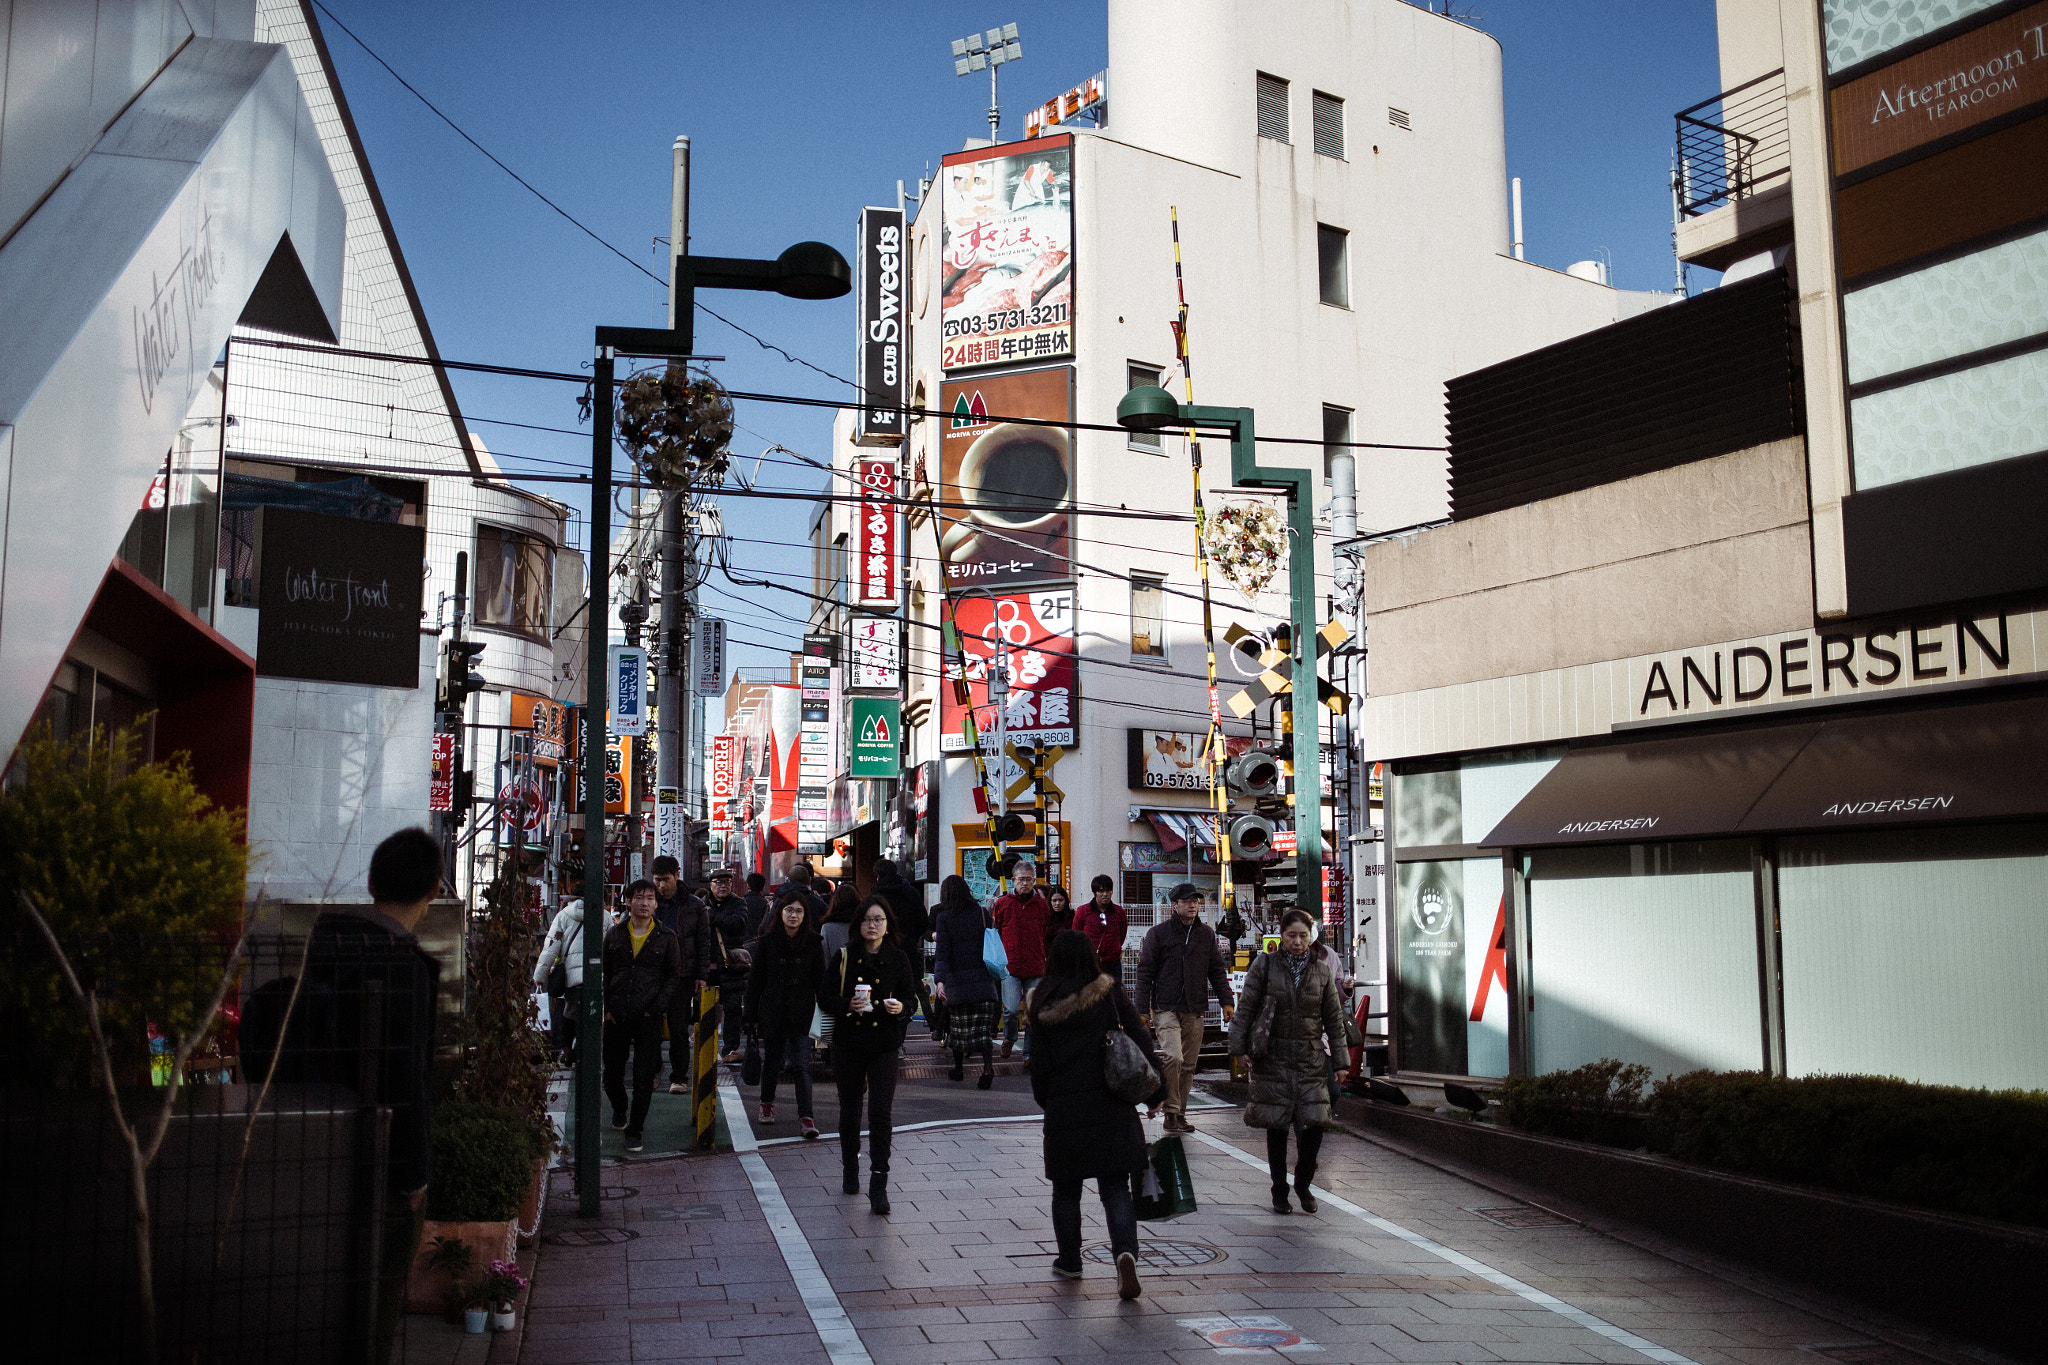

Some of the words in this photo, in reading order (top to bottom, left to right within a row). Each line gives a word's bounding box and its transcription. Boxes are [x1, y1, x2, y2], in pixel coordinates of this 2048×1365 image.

[1871, 49, 2024, 124] Afternoon
[1926, 75, 2018, 120] TEAROOM
[870, 225, 900, 343] Sweets
[960, 302, 1067, 335] 03-5731-3211
[884, 345, 897, 386] CLUB
[286, 565, 336, 602] Water
[947, 559, 1034, 578] モリバコーヒー
[1040, 596, 1071, 620] 2F
[1640, 612, 2010, 715] ANDERSEN
[619, 674, 629, 713] クリニック
[629, 669, 638, 701] メンタル
[431, 752, 446, 760] TOP
[714, 739, 729, 794] PREGO
[1822, 796, 1954, 816] ANDERSEN
[660, 807, 670, 856] リブレット
[713, 820, 733, 828] SLOT
[1559, 817, 1659, 834] ANDERSEN
[1322, 880, 1340, 888] STOP
